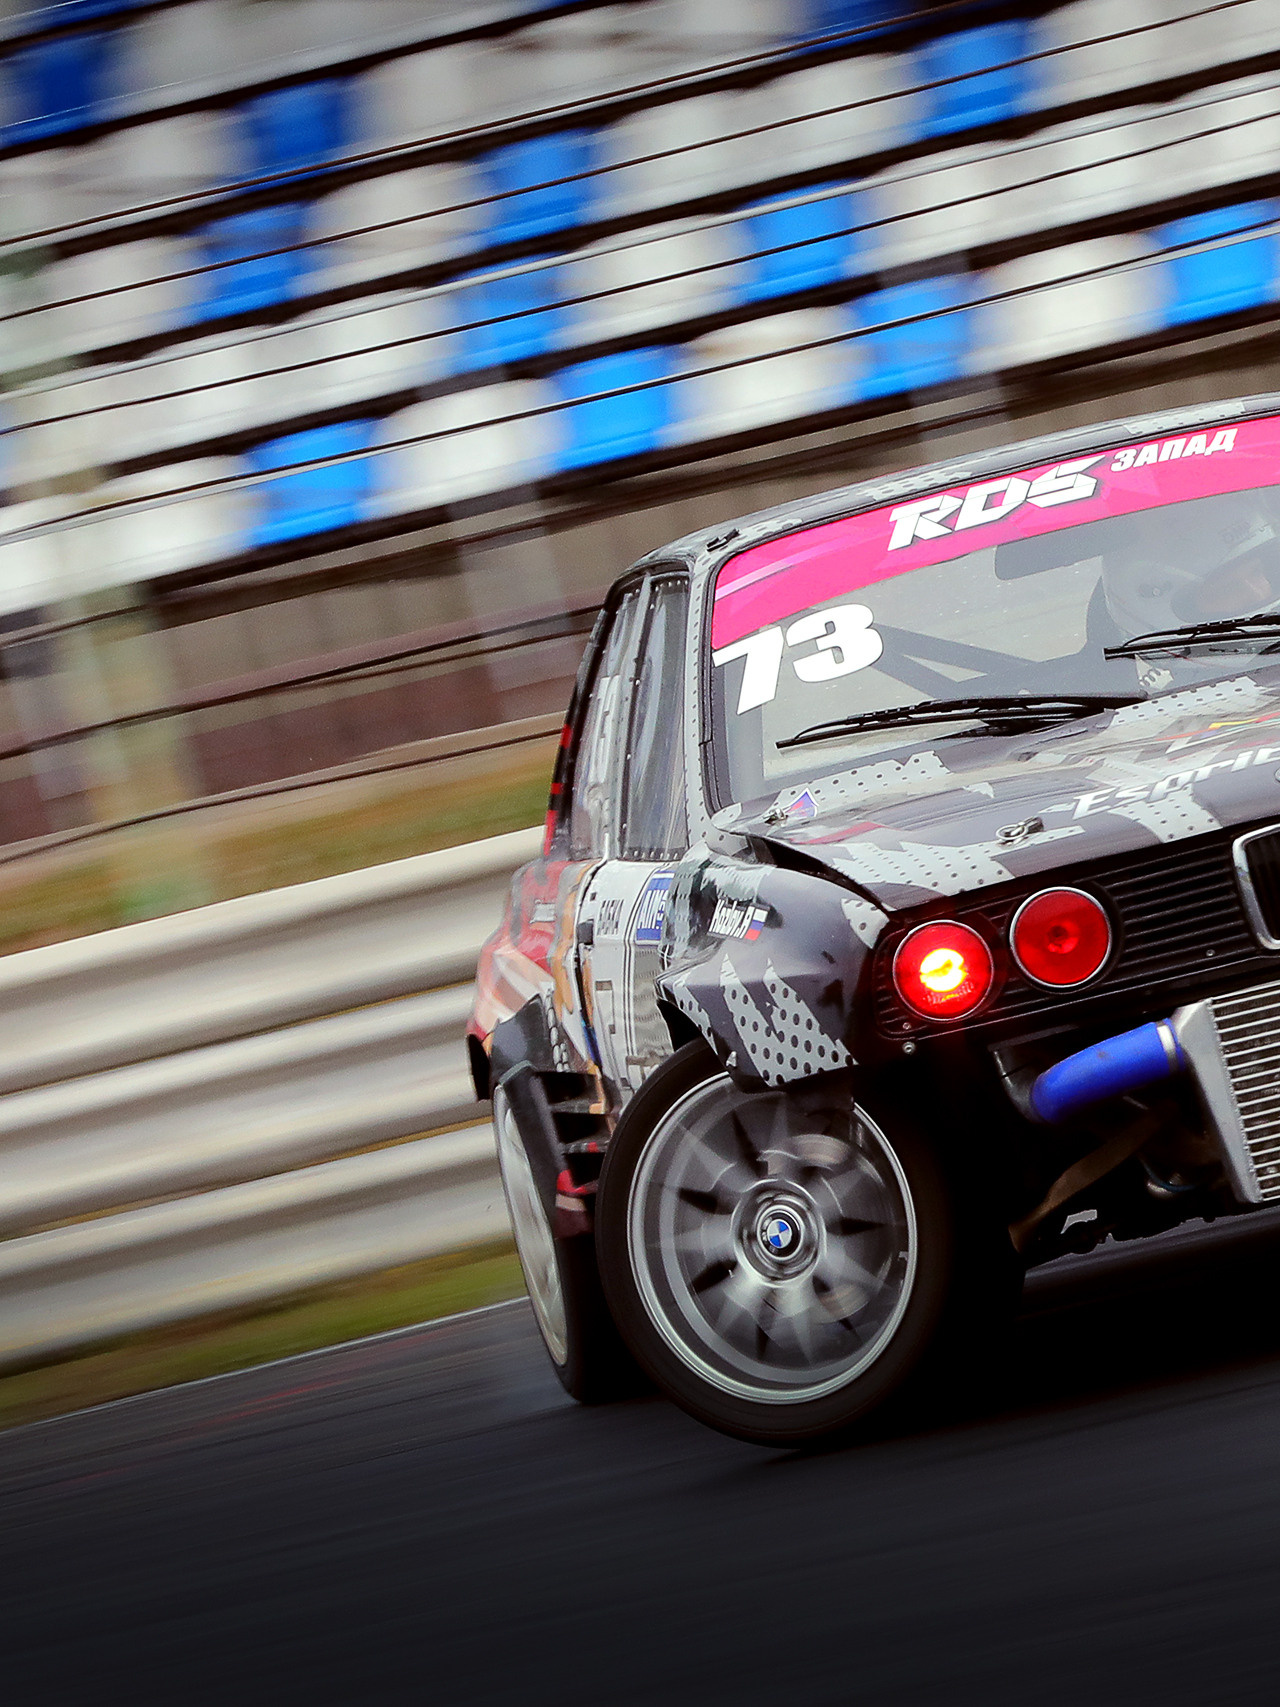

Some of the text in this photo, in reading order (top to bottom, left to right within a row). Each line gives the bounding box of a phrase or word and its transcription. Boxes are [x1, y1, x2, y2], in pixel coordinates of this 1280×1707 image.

[1110, 428, 1239, 472] ЗАПАД
[888, 455, 1106, 551] RDS
[712, 603, 883, 715] 73
